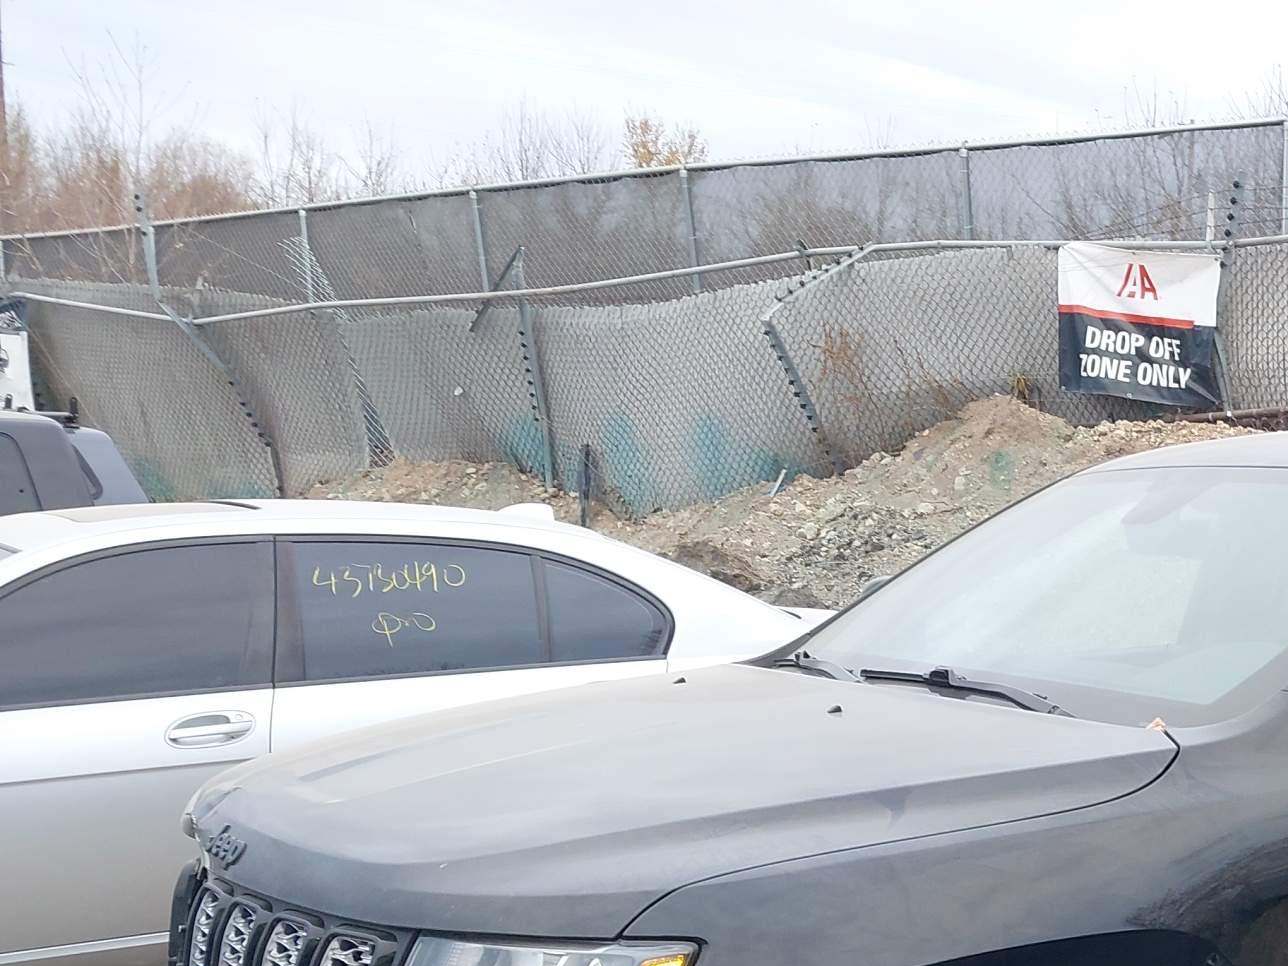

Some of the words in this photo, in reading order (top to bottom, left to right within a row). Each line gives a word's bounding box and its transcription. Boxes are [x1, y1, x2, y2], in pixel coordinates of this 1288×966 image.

[1085, 325, 1145, 356] DROP
[1150, 336, 1181, 361] OFF
[1137, 362, 1192, 389] ONLY
